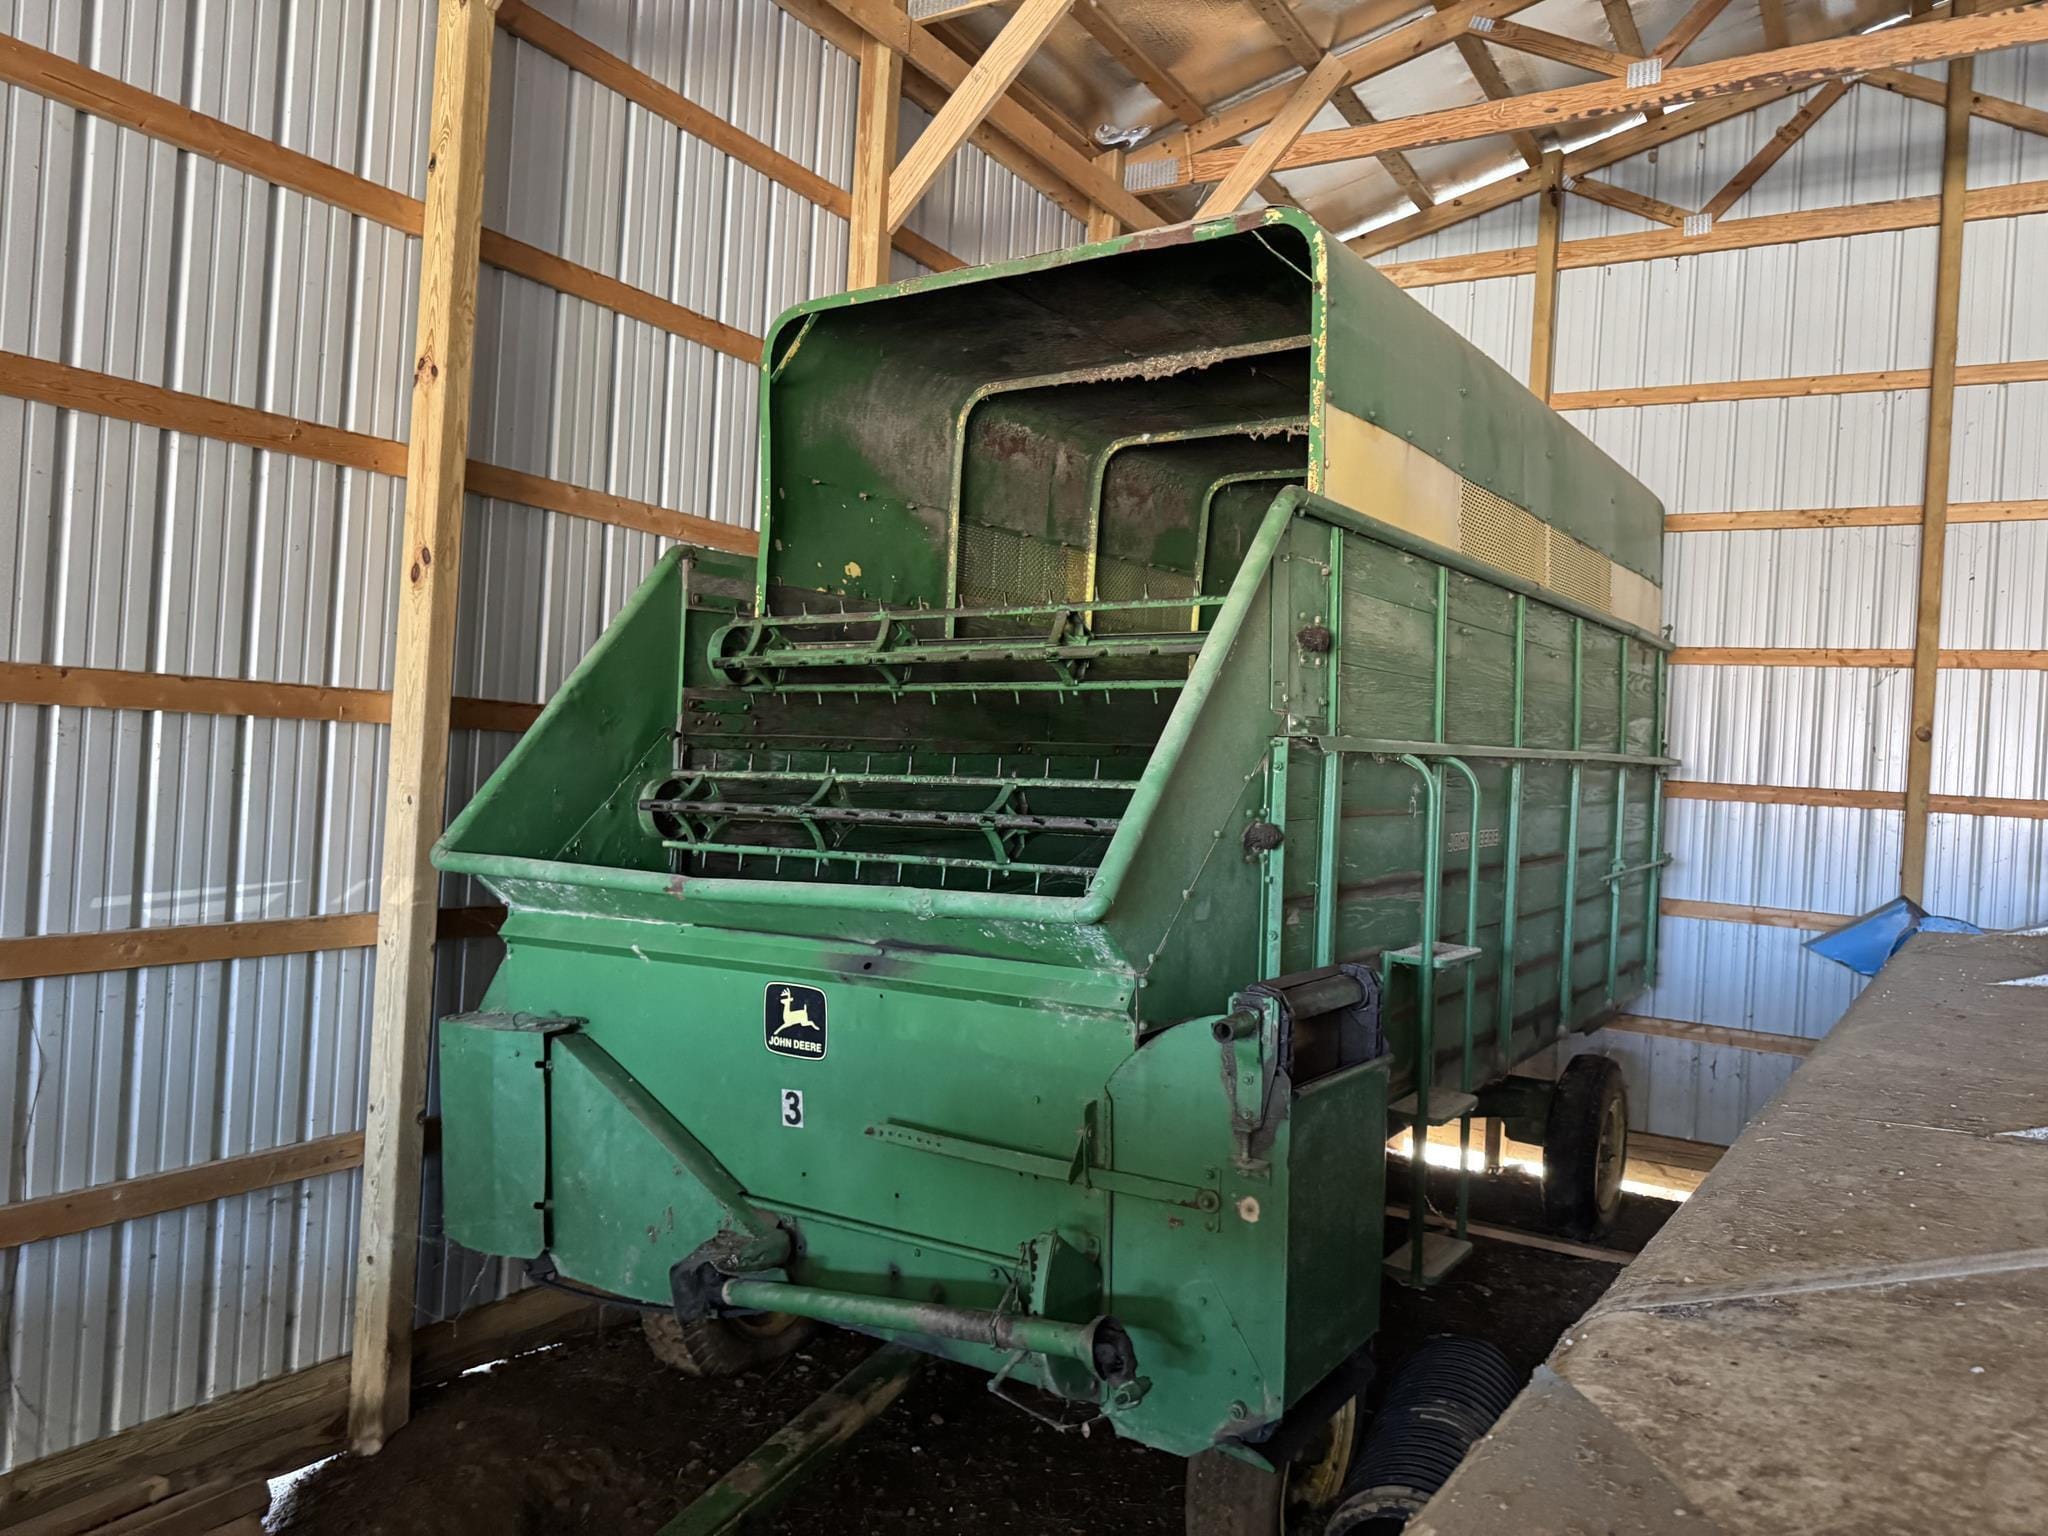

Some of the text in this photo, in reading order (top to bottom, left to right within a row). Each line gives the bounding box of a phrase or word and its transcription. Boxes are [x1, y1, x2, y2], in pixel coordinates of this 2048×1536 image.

[1475, 828, 1499, 848] EERE
[768, 1035, 823, 1053] JOHN DEERE
[784, 1091, 802, 1126] 3
